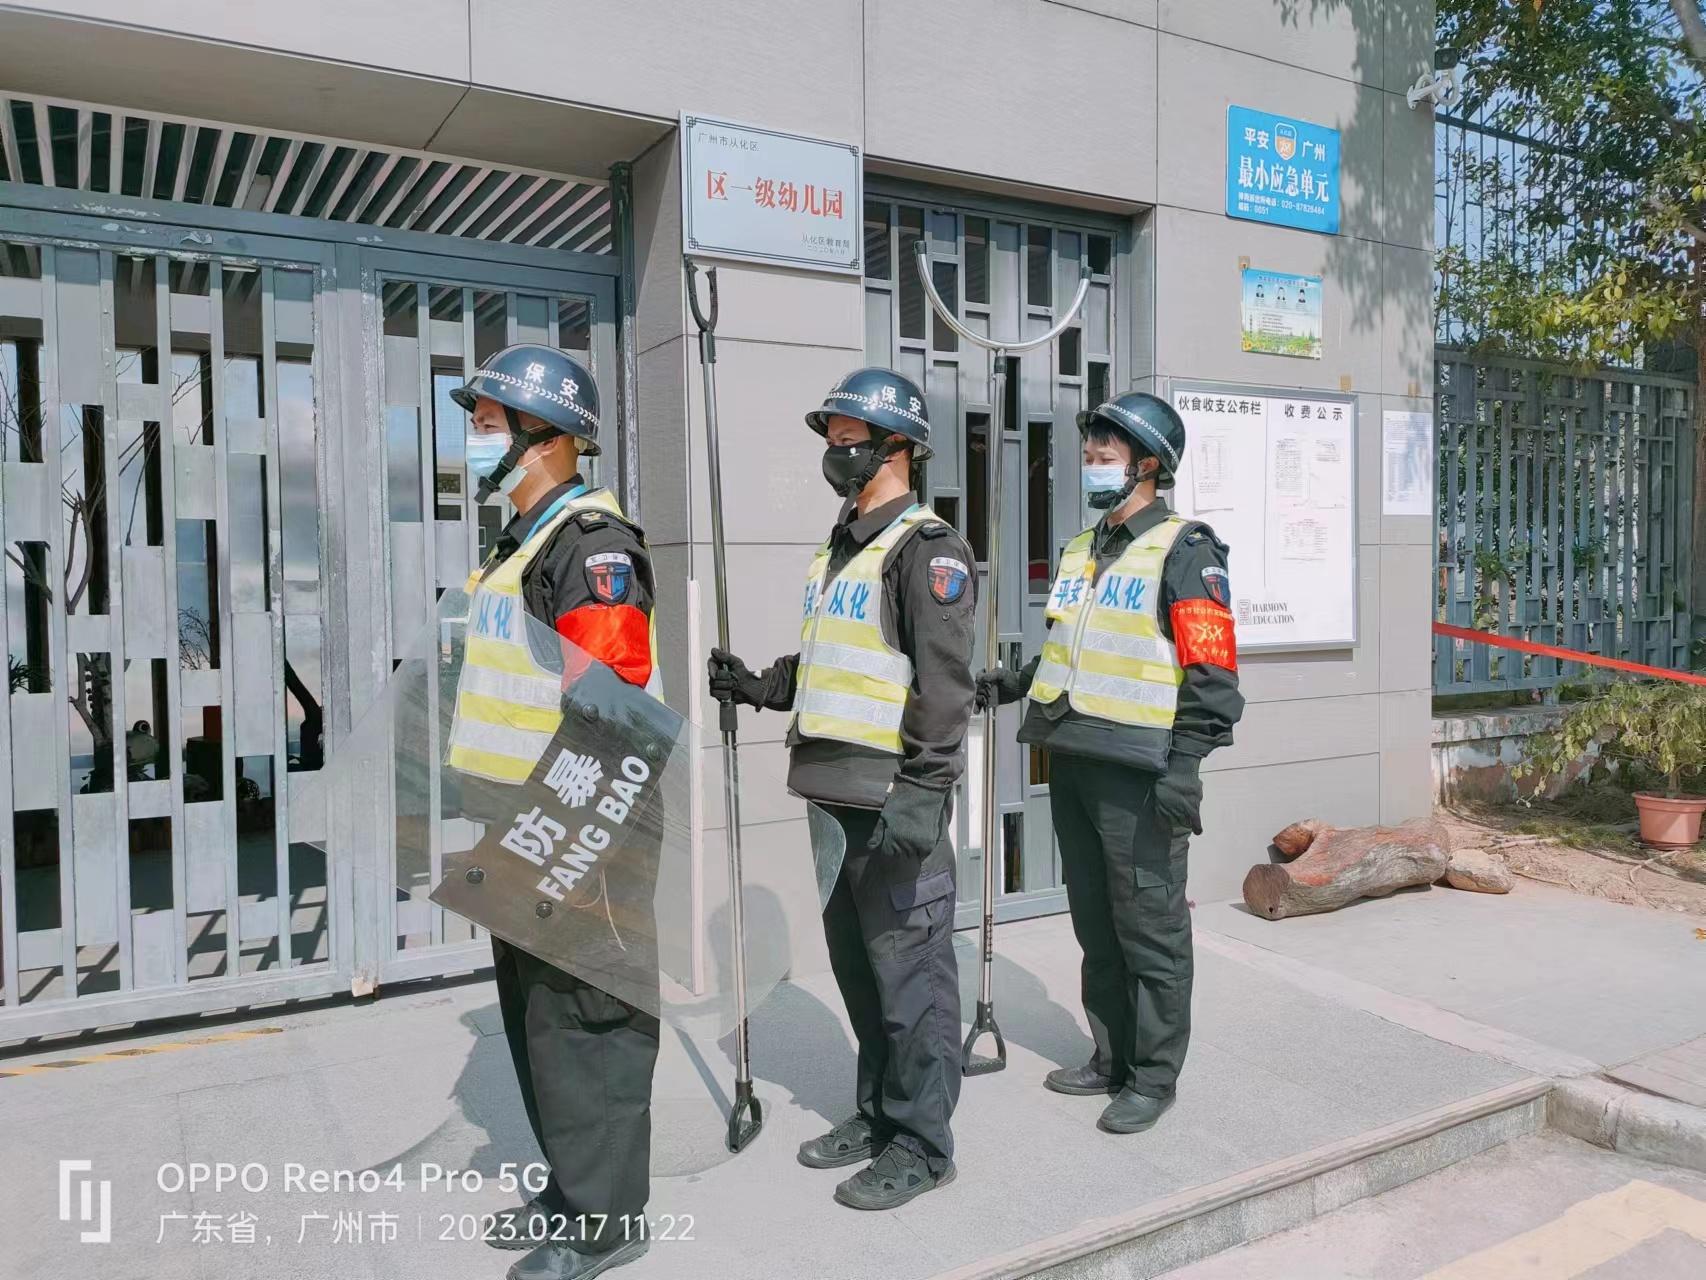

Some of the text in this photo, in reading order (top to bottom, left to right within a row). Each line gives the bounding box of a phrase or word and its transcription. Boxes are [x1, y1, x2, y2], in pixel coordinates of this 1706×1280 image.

[698, 132, 760, 152] 广州市从化区
[1244, 127, 1326, 162] 平安 广州
[706, 169, 844, 220] 区一级幼儿园
[1238, 155, 1330, 203] 最小应急单元
[524, 362, 580, 401] 保安
[881, 385, 922, 415] 保安
[1178, 395, 1262, 416] 伙食收支公布栏
[1284, 403, 1344, 422] 收费公示
[828, 580, 871, 620] 从化
[1054, 575, 1146, 610] 平安 从化
[1252, 602, 1288, 613] HARMONY
[476, 594, 513, 640] 从化
[1252, 614, 1295, 625] EDUCATION
[499, 747, 605, 867] 防暴
[535, 755, 650, 902] FANG BAO
